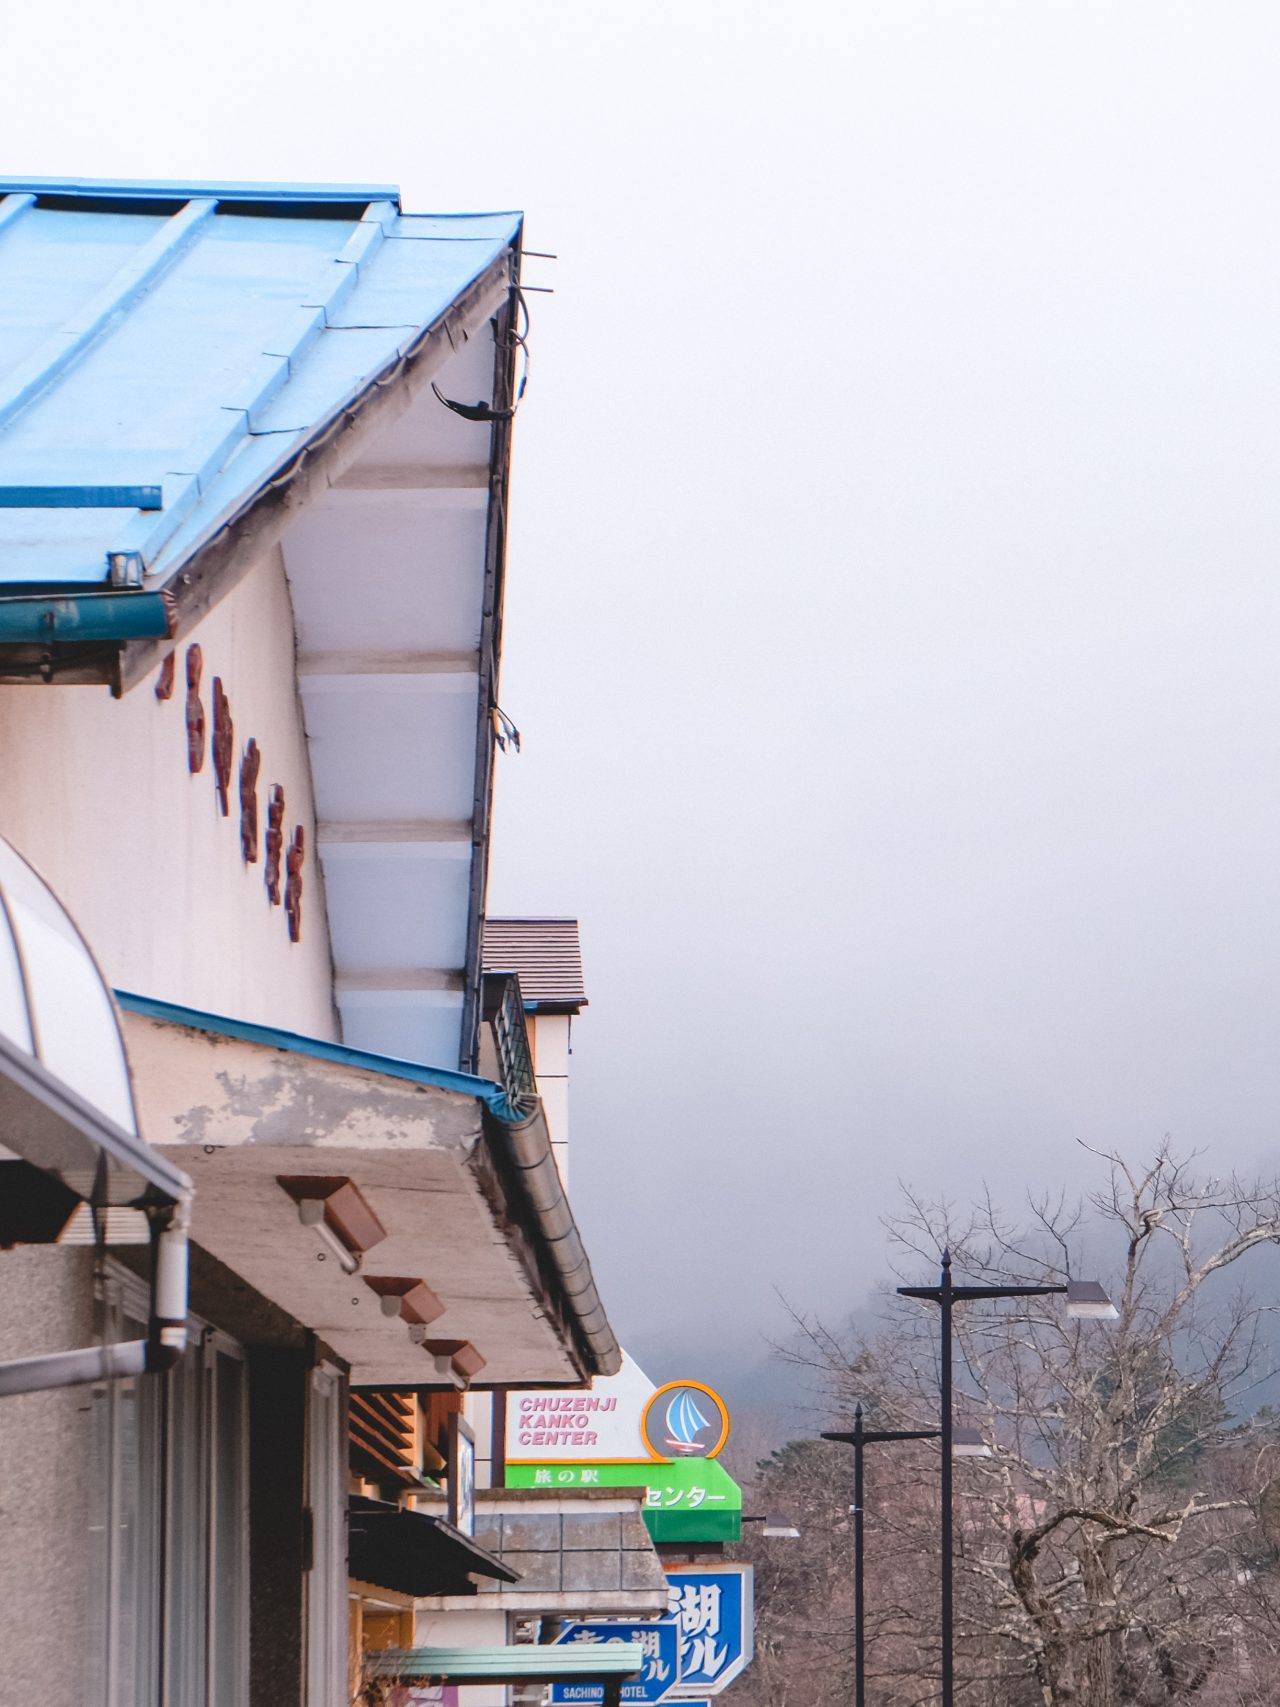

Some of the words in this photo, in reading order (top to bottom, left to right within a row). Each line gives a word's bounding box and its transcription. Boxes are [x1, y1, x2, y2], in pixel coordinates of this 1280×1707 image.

[518, 1397, 617, 1412] CHUZENJI
[518, 1414, 589, 1429] KANKO
[518, 1431, 598, 1446] CENTER
[534, 1469, 599, 1484] 旅の駅
